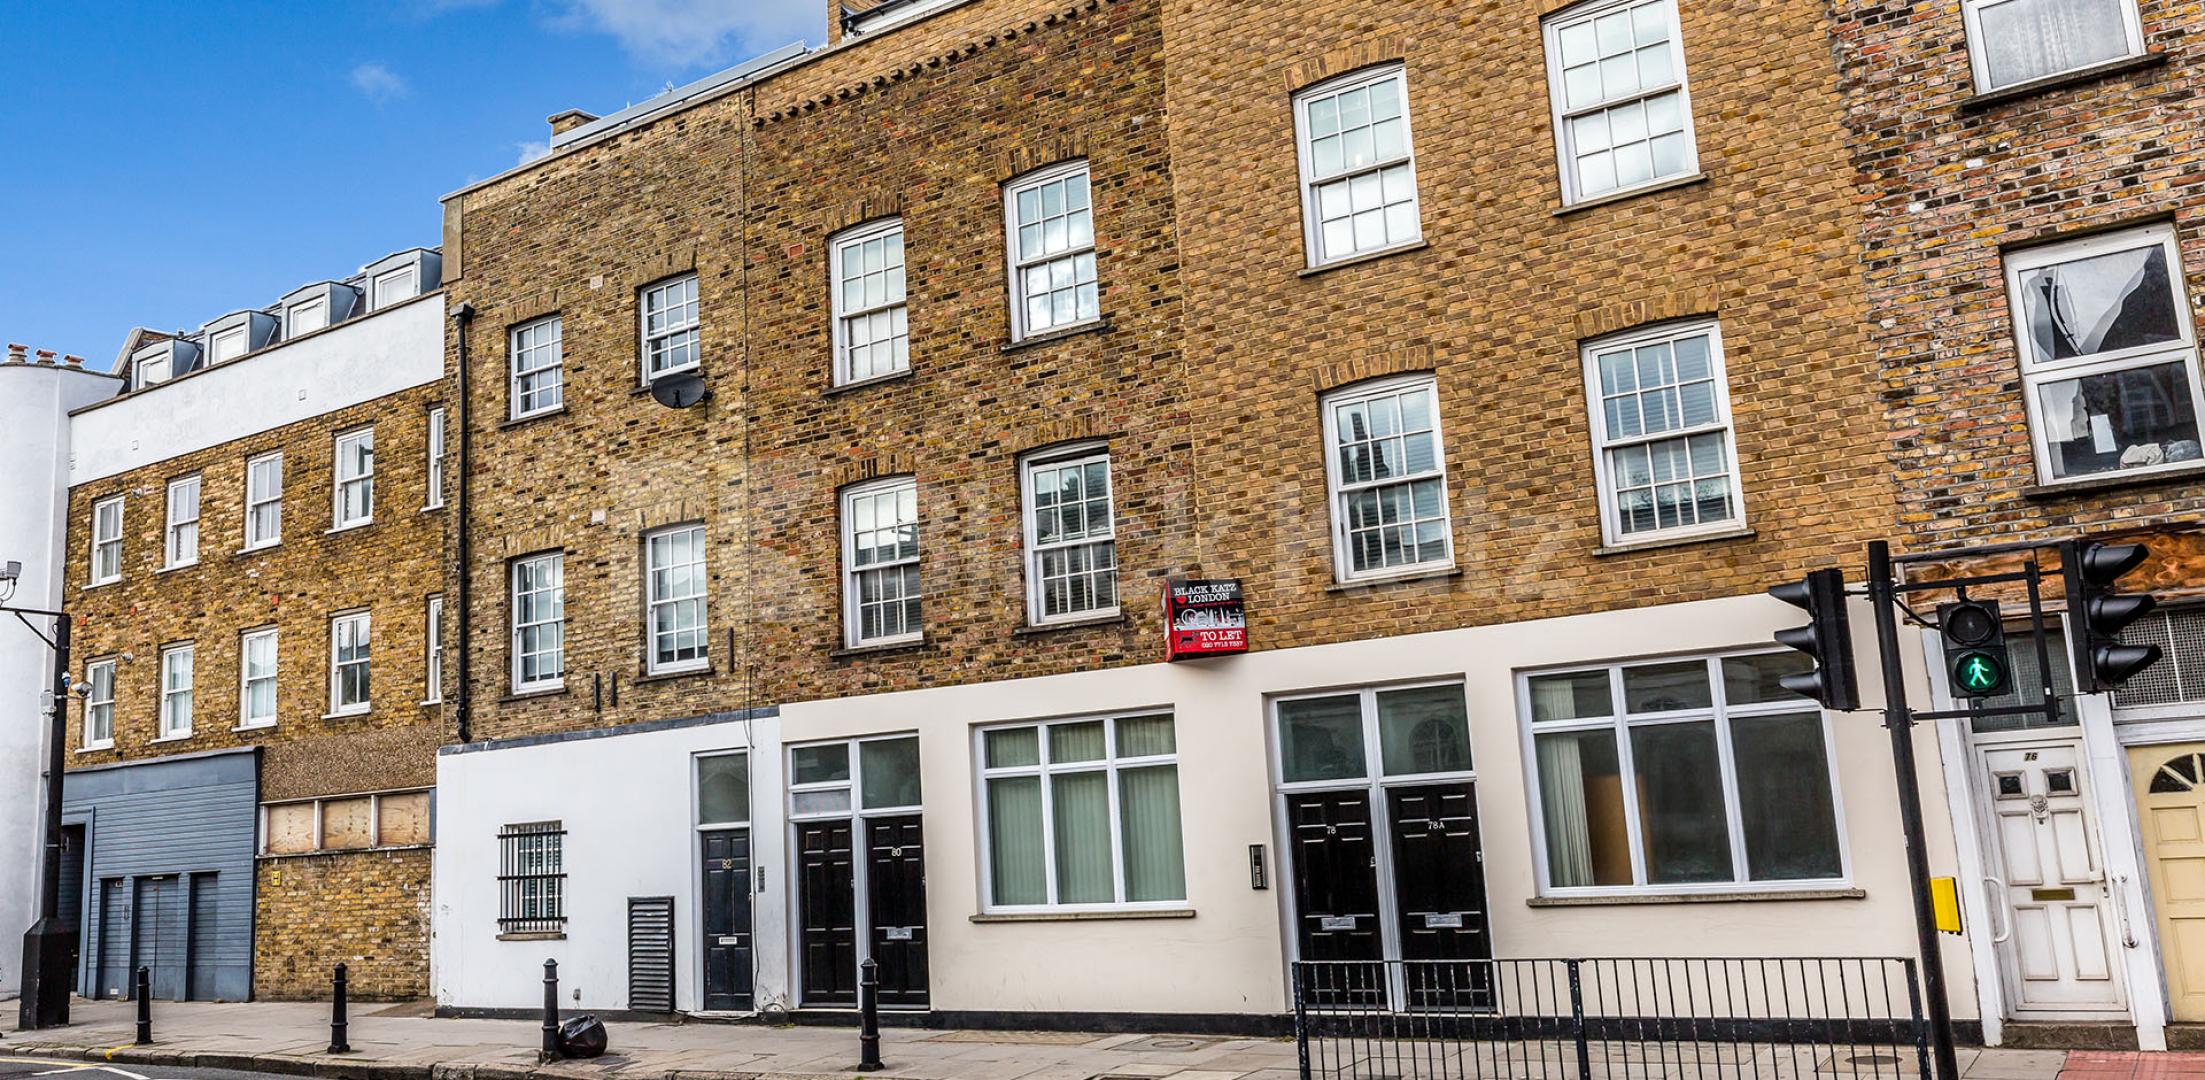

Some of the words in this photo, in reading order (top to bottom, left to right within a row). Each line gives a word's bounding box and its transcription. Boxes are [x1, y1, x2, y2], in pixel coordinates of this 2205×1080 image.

[1174, 585, 1208, 596] BLACK
[1210, 583, 1237, 593] KATZ
[1187, 592, 1230, 603] LONDON
[1200, 631, 1217, 641] TO
[1218, 630, 1242, 640] LET
[2024, 752, 2038, 761] 76
[1326, 825, 1337, 834] 78
[1427, 821, 1445, 830] 78A
[891, 847, 902, 856] 80
[722, 858, 732, 869] 82
